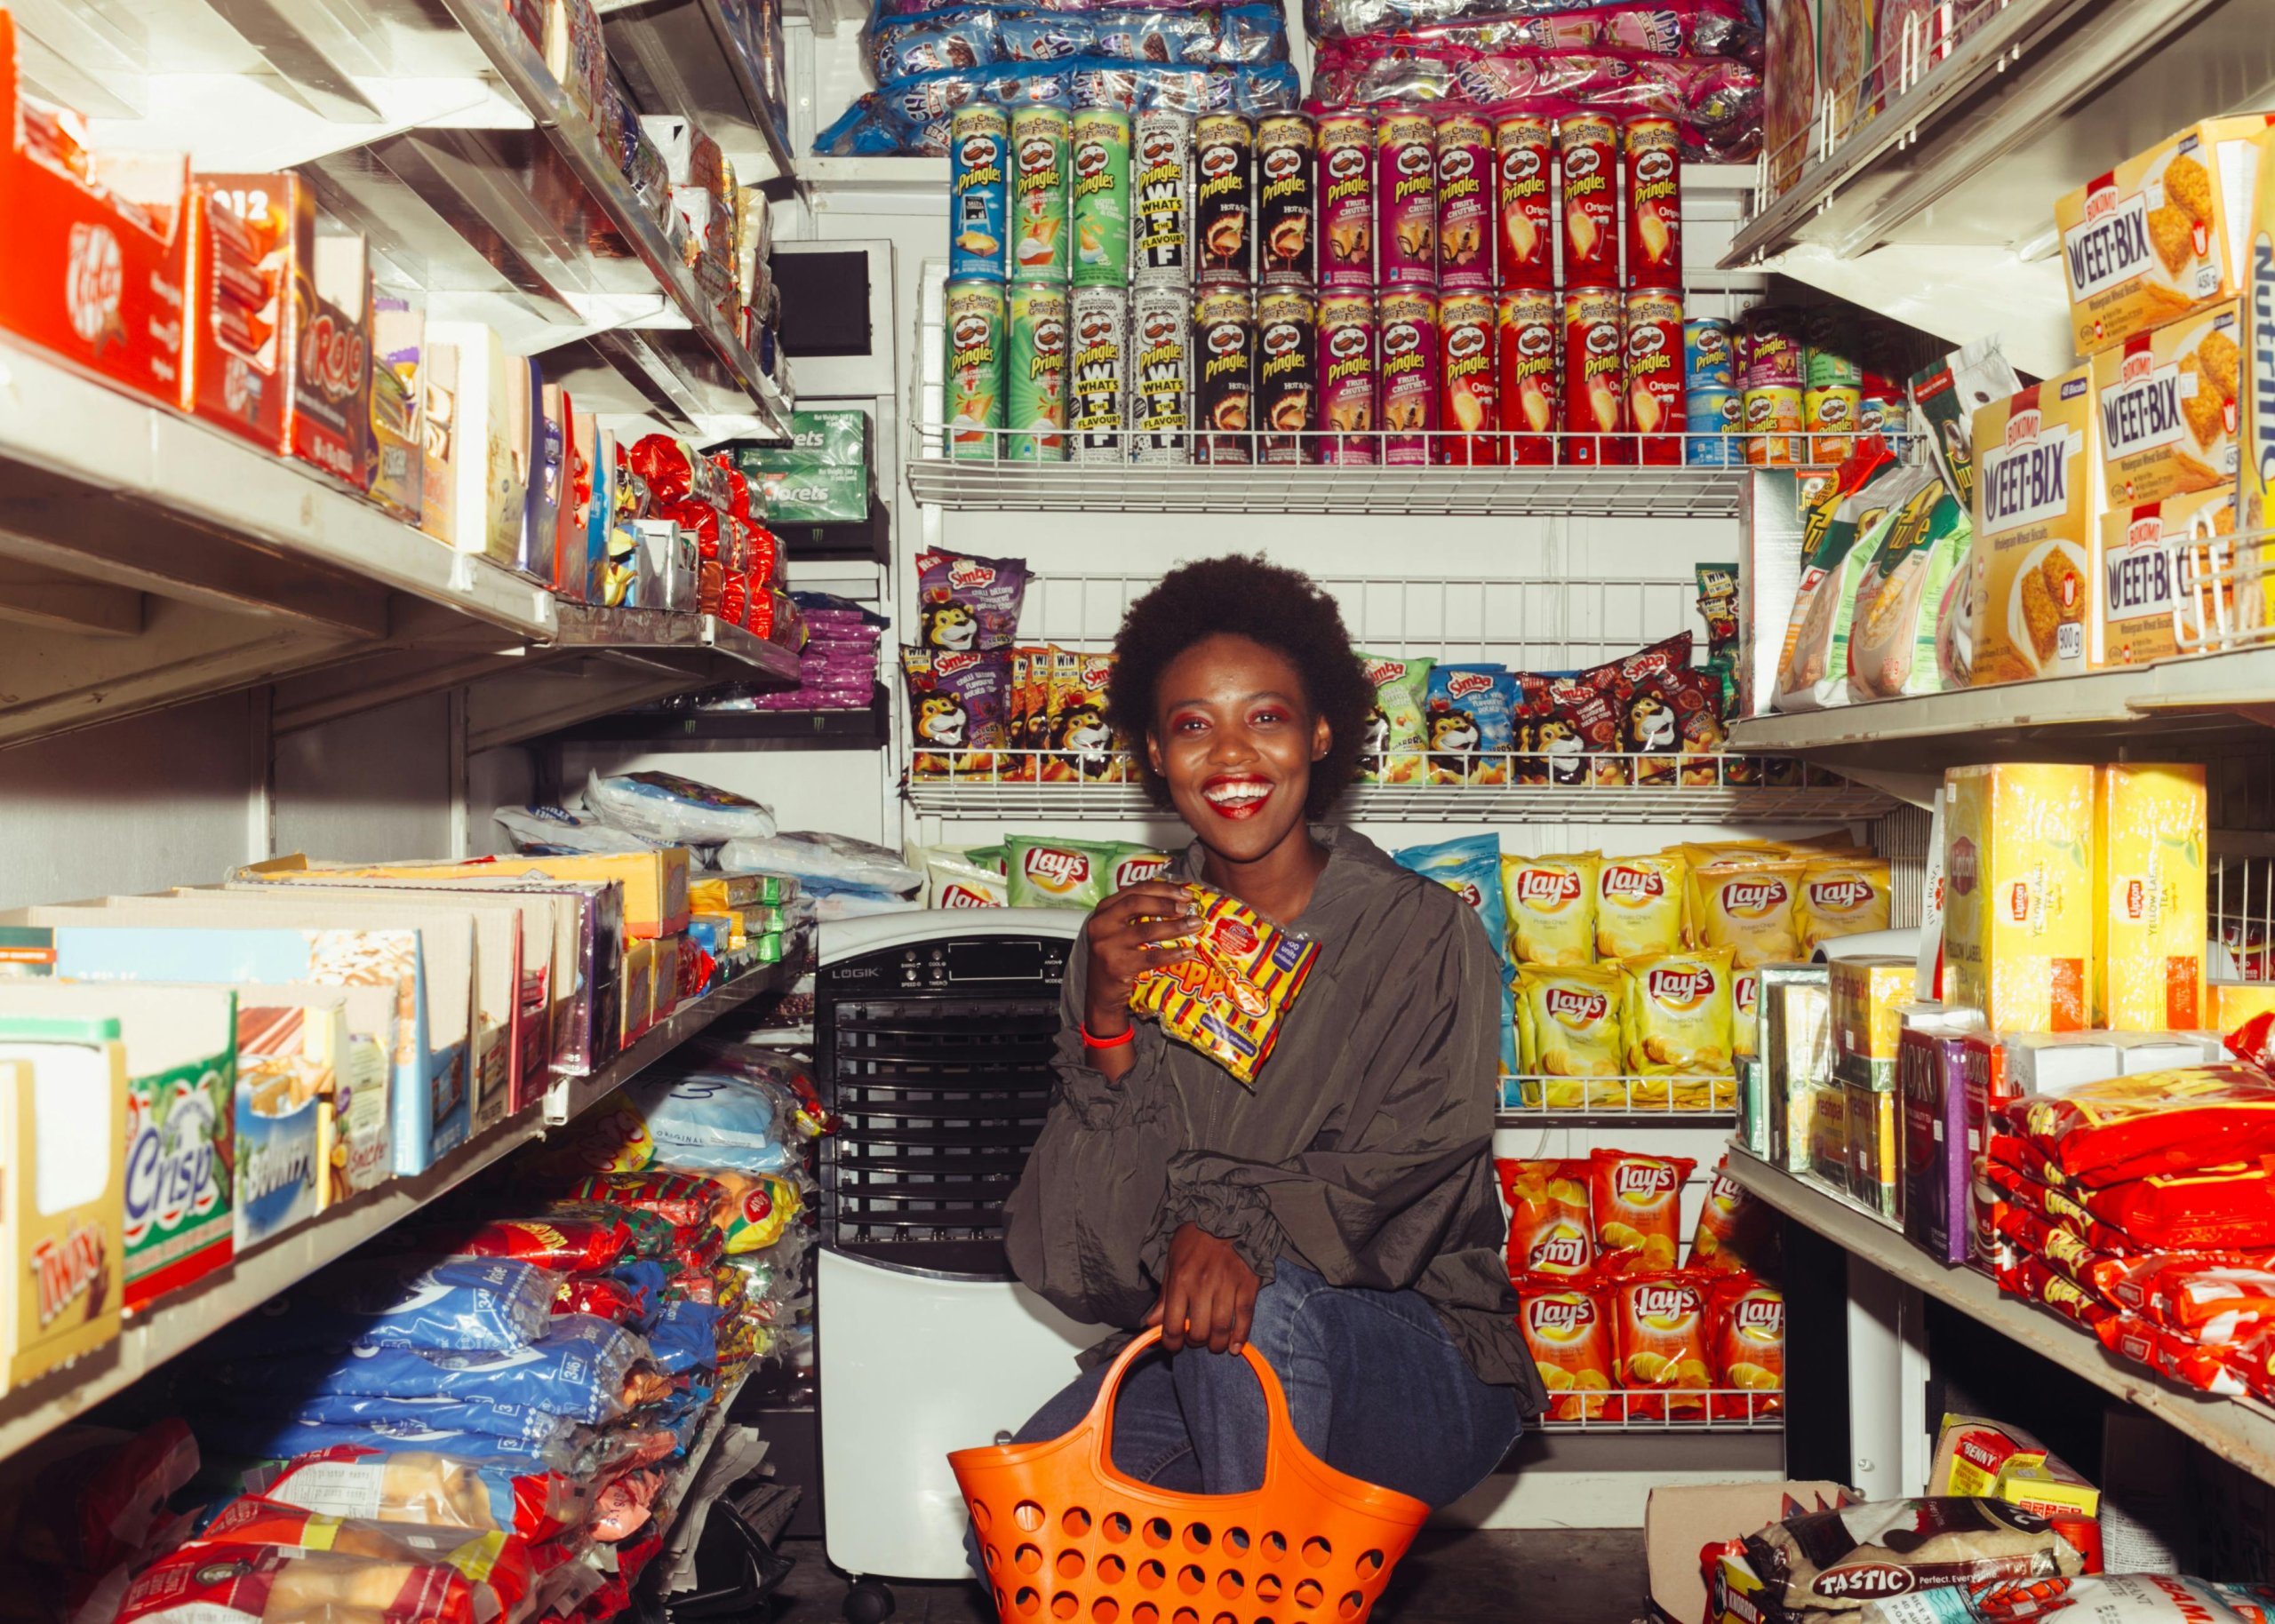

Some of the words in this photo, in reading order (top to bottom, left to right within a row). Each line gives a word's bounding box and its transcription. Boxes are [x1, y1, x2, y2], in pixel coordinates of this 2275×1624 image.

[958, 166, 1002, 195] Pringles
[1018, 168, 1060, 201] Pringles
[1074, 171, 1114, 201] Pringles
[1139, 161, 1182, 196] Pringles
[1200, 171, 1242, 206] Pringles
[1262, 174, 1305, 209] Pringles
[1328, 175, 1369, 209] Pringles
[1395, 172, 1433, 204] Pringle
[1440, 174, 1480, 209] Pringles
[1503, 174, 1545, 211] Pringles
[1565, 171, 1606, 209] Pringles
[1635, 178, 1677, 211] Pringles
[1142, 200, 1182, 212] WHAT'S
[2086, 191, 2116, 222] BOKOMO
[1142, 235, 1185, 248] FLAVOUR?
[2068, 207, 2149, 290] WEET-BIX
[951, 343, 994, 379] Pringles
[1075, 341, 1119, 377] Pringles
[1140, 343, 1183, 378] Pringles
[1206, 351, 1249, 382] Pringles
[1630, 351, 1671, 380] Pringles
[1754, 338, 1786, 363] Pringles
[1263, 350, 1305, 385] Pringles
[1329, 354, 1371, 386] Pringles
[1384, 351, 1425, 384] Pringles
[1447, 352, 1489, 386] Pringles
[1517, 353, 1553, 384] Pringle
[1585, 352, 1620, 382] Pringle
[2123, 356, 2151, 383] BOKOMO
[1078, 380, 1118, 393] WHAT'S
[1143, 380, 1184, 393] WHAT'S
[1648, 381, 1680, 391] Original
[1078, 416, 1120, 428] FLAVOUR?
[1144, 415, 1185, 428] FLAVOUR?
[2103, 377, 2180, 449] WEET-BIX
[2008, 416, 2040, 446] BOKOMO
[1984, 441, 2065, 522] WEET-BIX
[2130, 522, 2159, 548] BOKOMO
[951, 567, 995, 586] Simba
[2059, 630, 2072, 649] 900
[936, 653, 982, 674] Simba
[1371, 662, 1404, 682] imba
[1625, 656, 1664, 680] Simba
[1449, 674, 1493, 695] Simba
[1553, 687, 1594, 703] Simba
[1028, 848, 1086, 886] Lay's
[1521, 869, 1579, 906] Lay's
[1606, 868, 1659, 901] Lay's
[1727, 880, 1783, 911] Lay's
[1816, 880, 1867, 911] Lay's
[2129, 882, 2141, 917] Lipton
[2014, 884, 2025, 919] Lipton
[832, 967, 879, 979] LOGIK
[1653, 969, 1710, 1003] Lay's
[1550, 989, 1603, 1023] Lay's
[126, 1127, 213, 1221] Crisp
[1620, 1166, 1672, 1198] Lay's
[1535, 1297, 1590, 1333] Lay's
[1640, 1286, 1695, 1322] Lay's
[1962, 1441, 1997, 1468] BENNY
[1820, 1570, 1904, 1596] TASTIC
[1920, 1576, 1952, 1585] Perfect.
[1728, 1589, 1757, 1623] KNORROX
